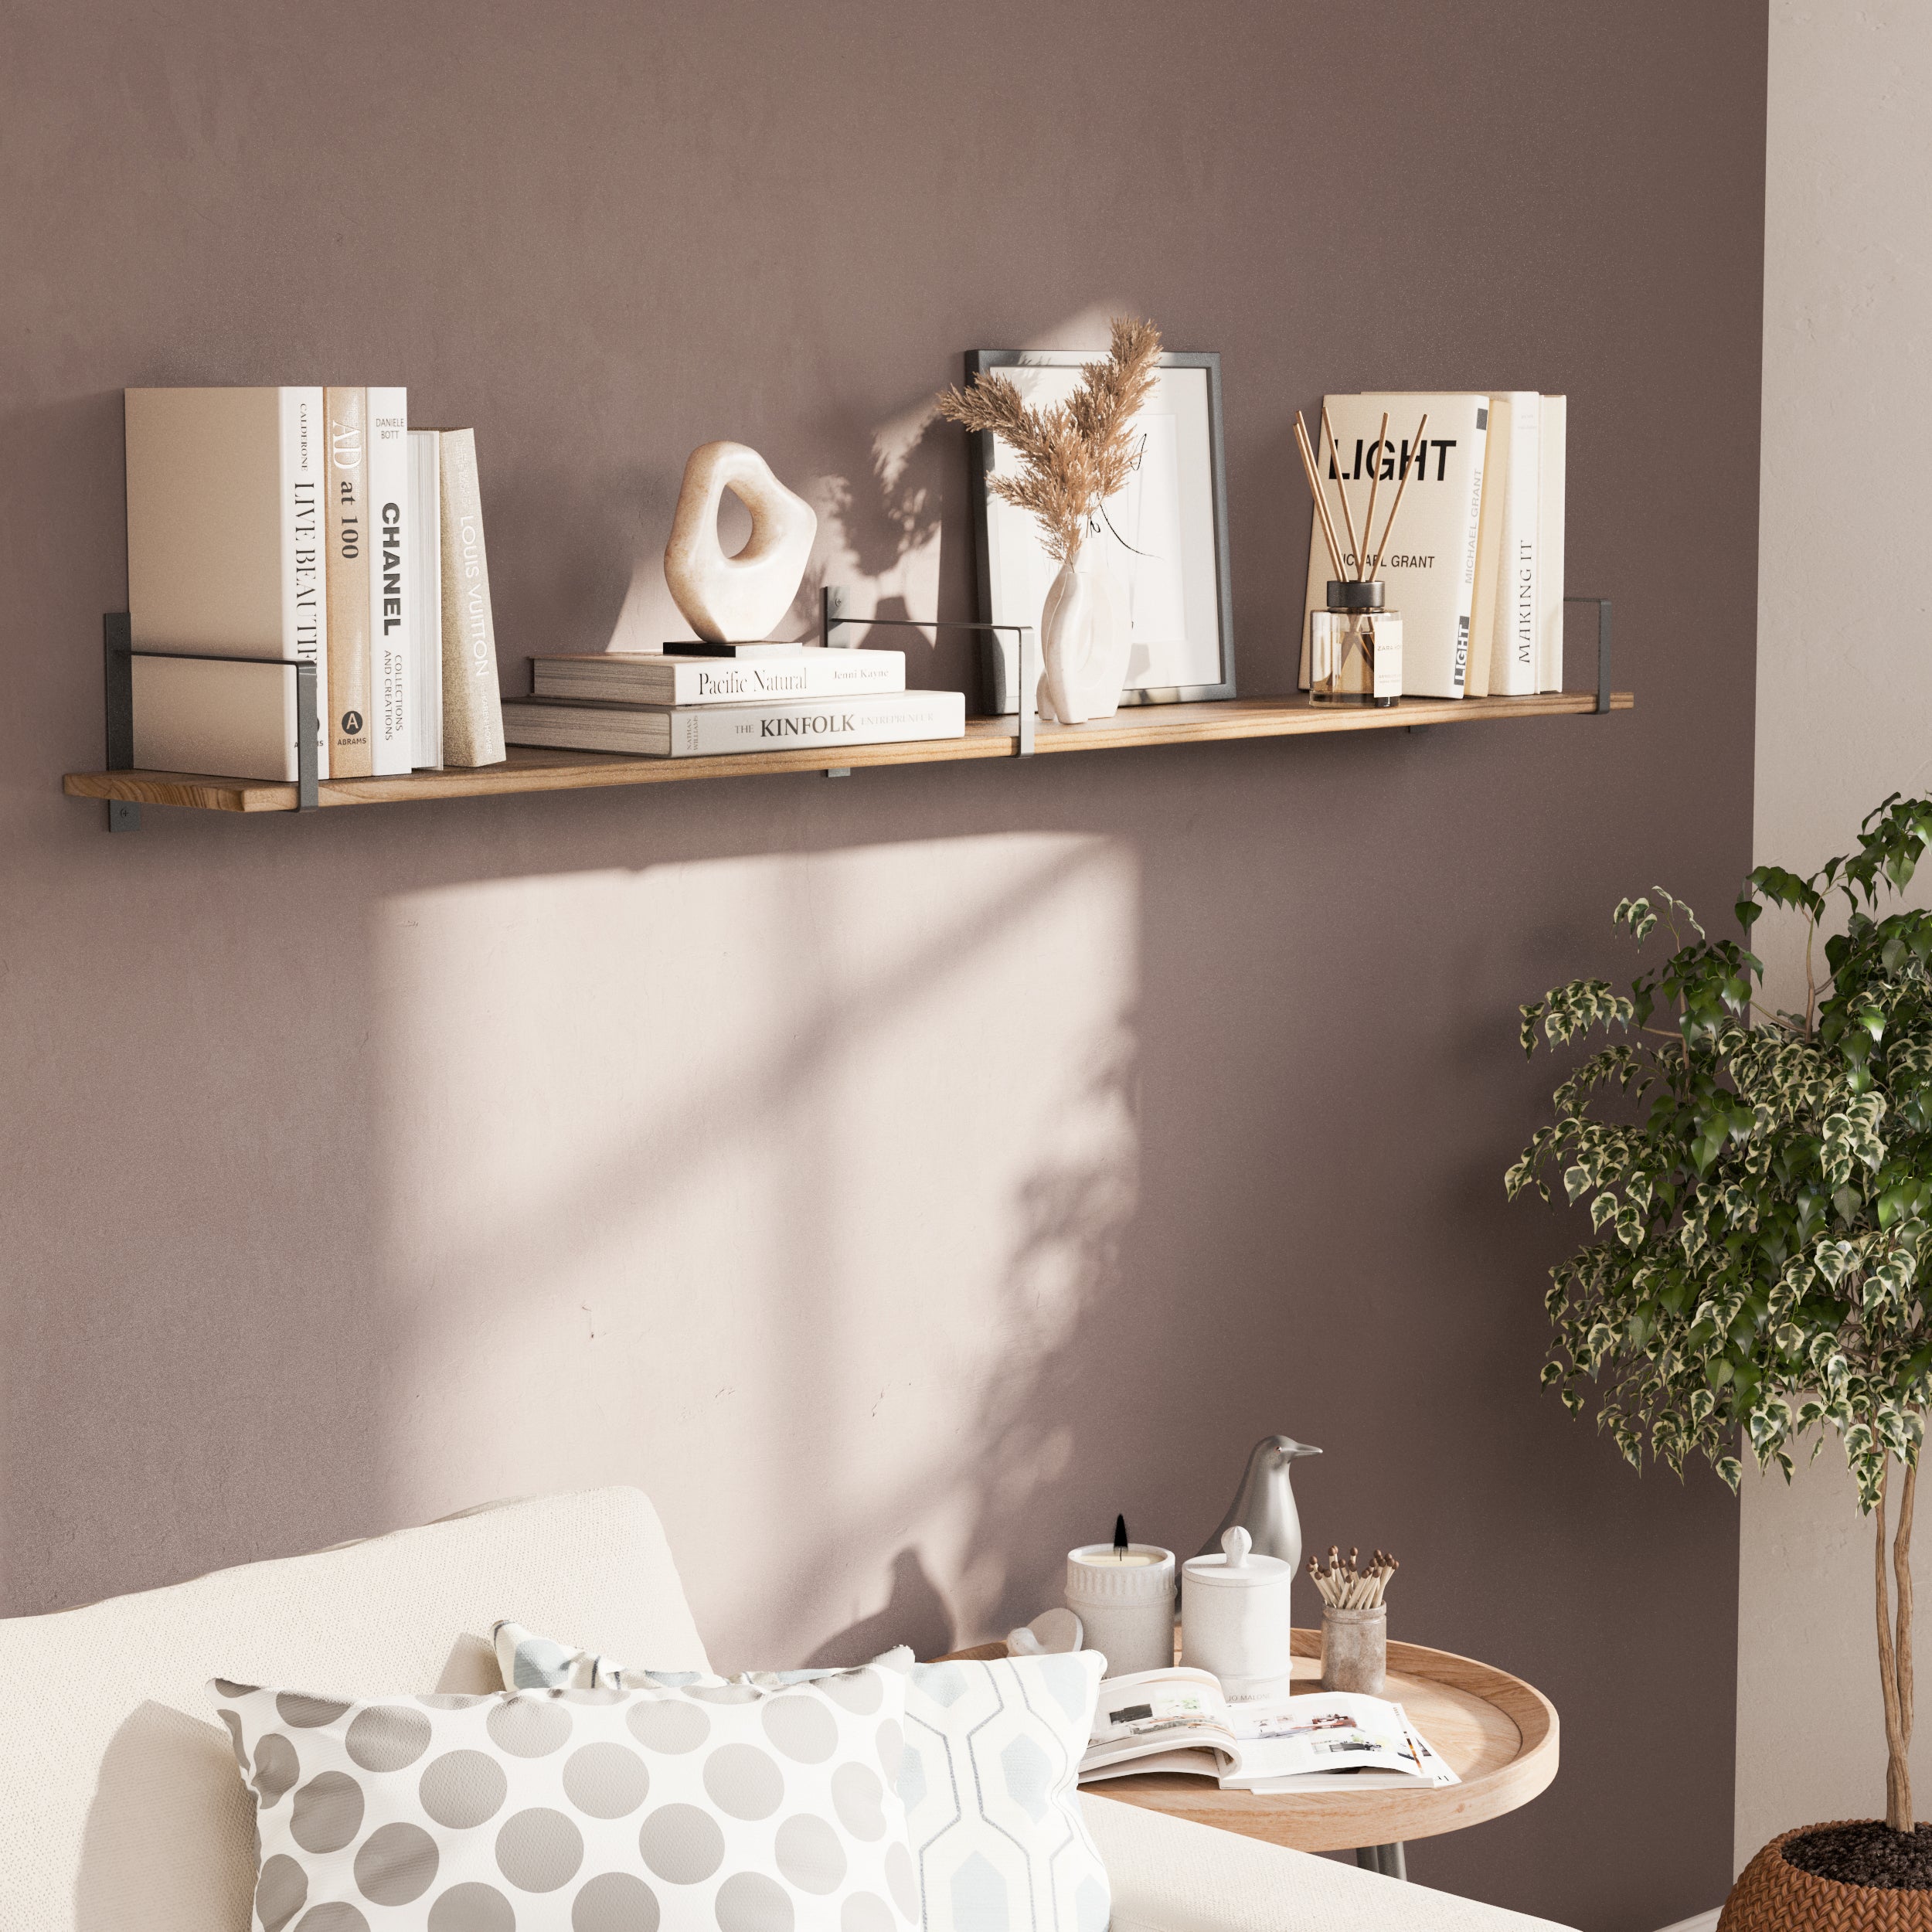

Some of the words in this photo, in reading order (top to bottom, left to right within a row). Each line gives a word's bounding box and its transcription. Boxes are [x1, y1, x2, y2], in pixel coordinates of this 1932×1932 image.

[300, 403, 308, 471] CALDERONE
[333, 420, 362, 469] AD
[376, 418, 405, 427] DANIELE
[381, 430, 400, 439] BOTT
[1328, 439, 1457, 481] LIGHT
[294, 482, 315, 541] LIVE
[341, 481, 355, 505] at
[1471, 468, 1481, 518] GRANT
[342, 516, 359, 559] 100
[460, 515, 480, 578] LOUIS
[1336, 553, 1387, 567] ICAL
[1391, 555, 1435, 569] GRANT
[1465, 522, 1478, 583] MICHAEL
[1520, 539, 1532, 560] IT
[382, 502, 401, 636] CHANEL
[296, 549, 318, 671] BEAUTIF
[468, 583, 490, 676] VUITTON
[1519, 569, 1532, 663] MAKING
[1454, 624, 1468, 680] LIGHT
[395, 655, 403, 731] COLLECTIONS
[699, 671, 747, 696] Pacific
[753, 668, 807, 692] Natural
[384, 679, 393, 740] CREATIONS
[735, 725, 754, 734] THE
[760, 714, 855, 737] KINFOLK
[337, 737, 367, 746] ABRAMS
